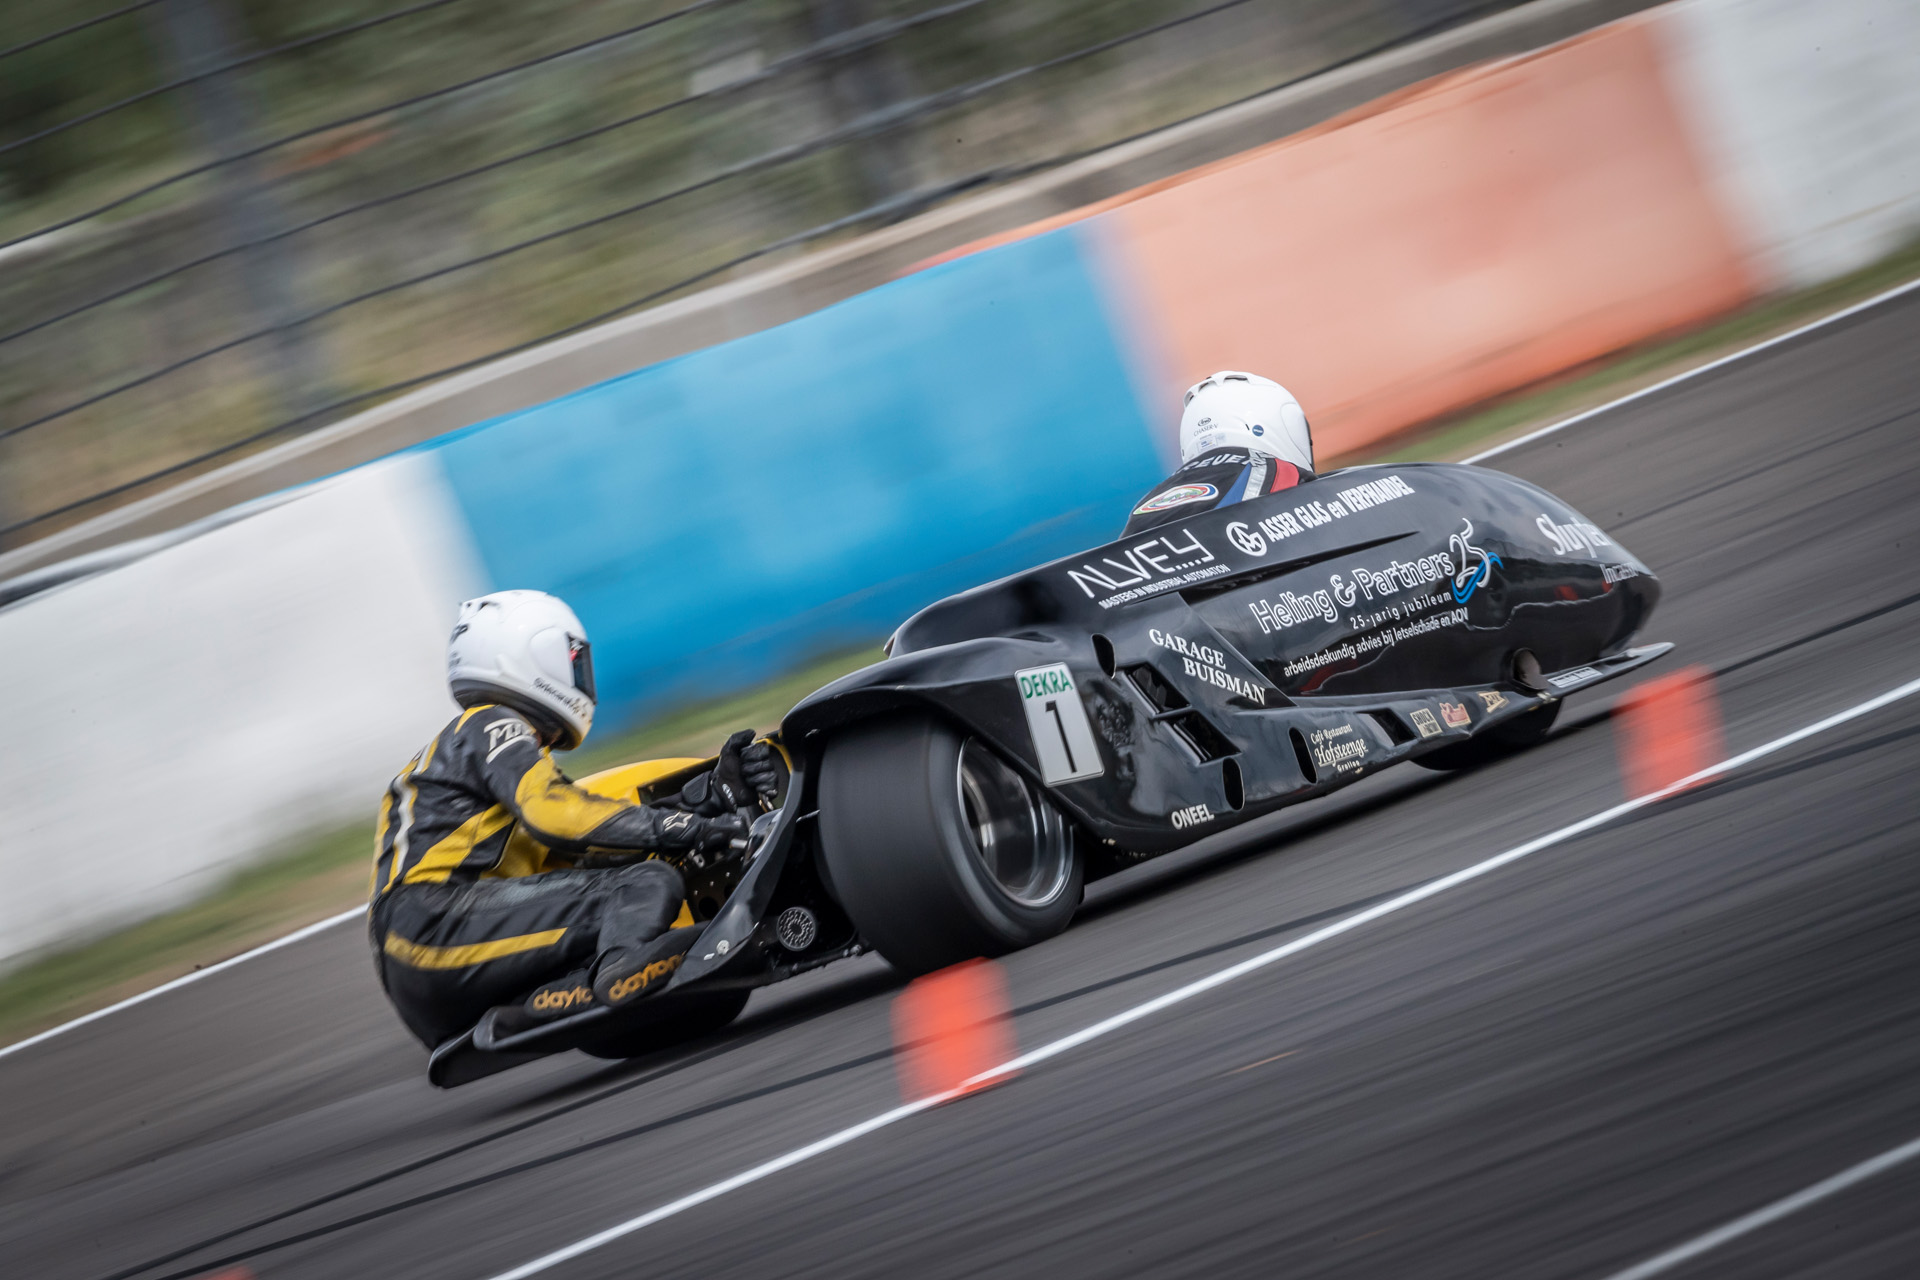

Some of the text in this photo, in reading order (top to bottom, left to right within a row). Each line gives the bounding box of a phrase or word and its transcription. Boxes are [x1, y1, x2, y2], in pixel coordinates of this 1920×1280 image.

[1327, 498, 1350, 519] en
[1336, 474, 1416, 513] VERFHANDEL
[1258, 511, 1305, 543] ASSER
[1293, 500, 1332, 529] GLAS
[1098, 563, 1231, 610] MASTERS IN INDUSTRIAL AUTOMATION
[1249, 551, 1456, 634] Heling & Partners
[1350, 591, 1453, 630] 25-jarig jubileum
[1148, 628, 1227, 670] GARAGE
[1284, 607, 1469, 677] arbeidsdeskundig advies bij letselschade en AOV
[1019, 669, 1073, 699] DEKRA
[1182, 657, 1265, 706] BUISMAN
[1045, 700, 1077, 773] 1
[1323, 723, 1353, 740] Restaurant
[1314, 738, 1368, 768] Hofsteenge
[1171, 803, 1215, 830] ONEEL
[608, 951, 685, 1002] dayton
